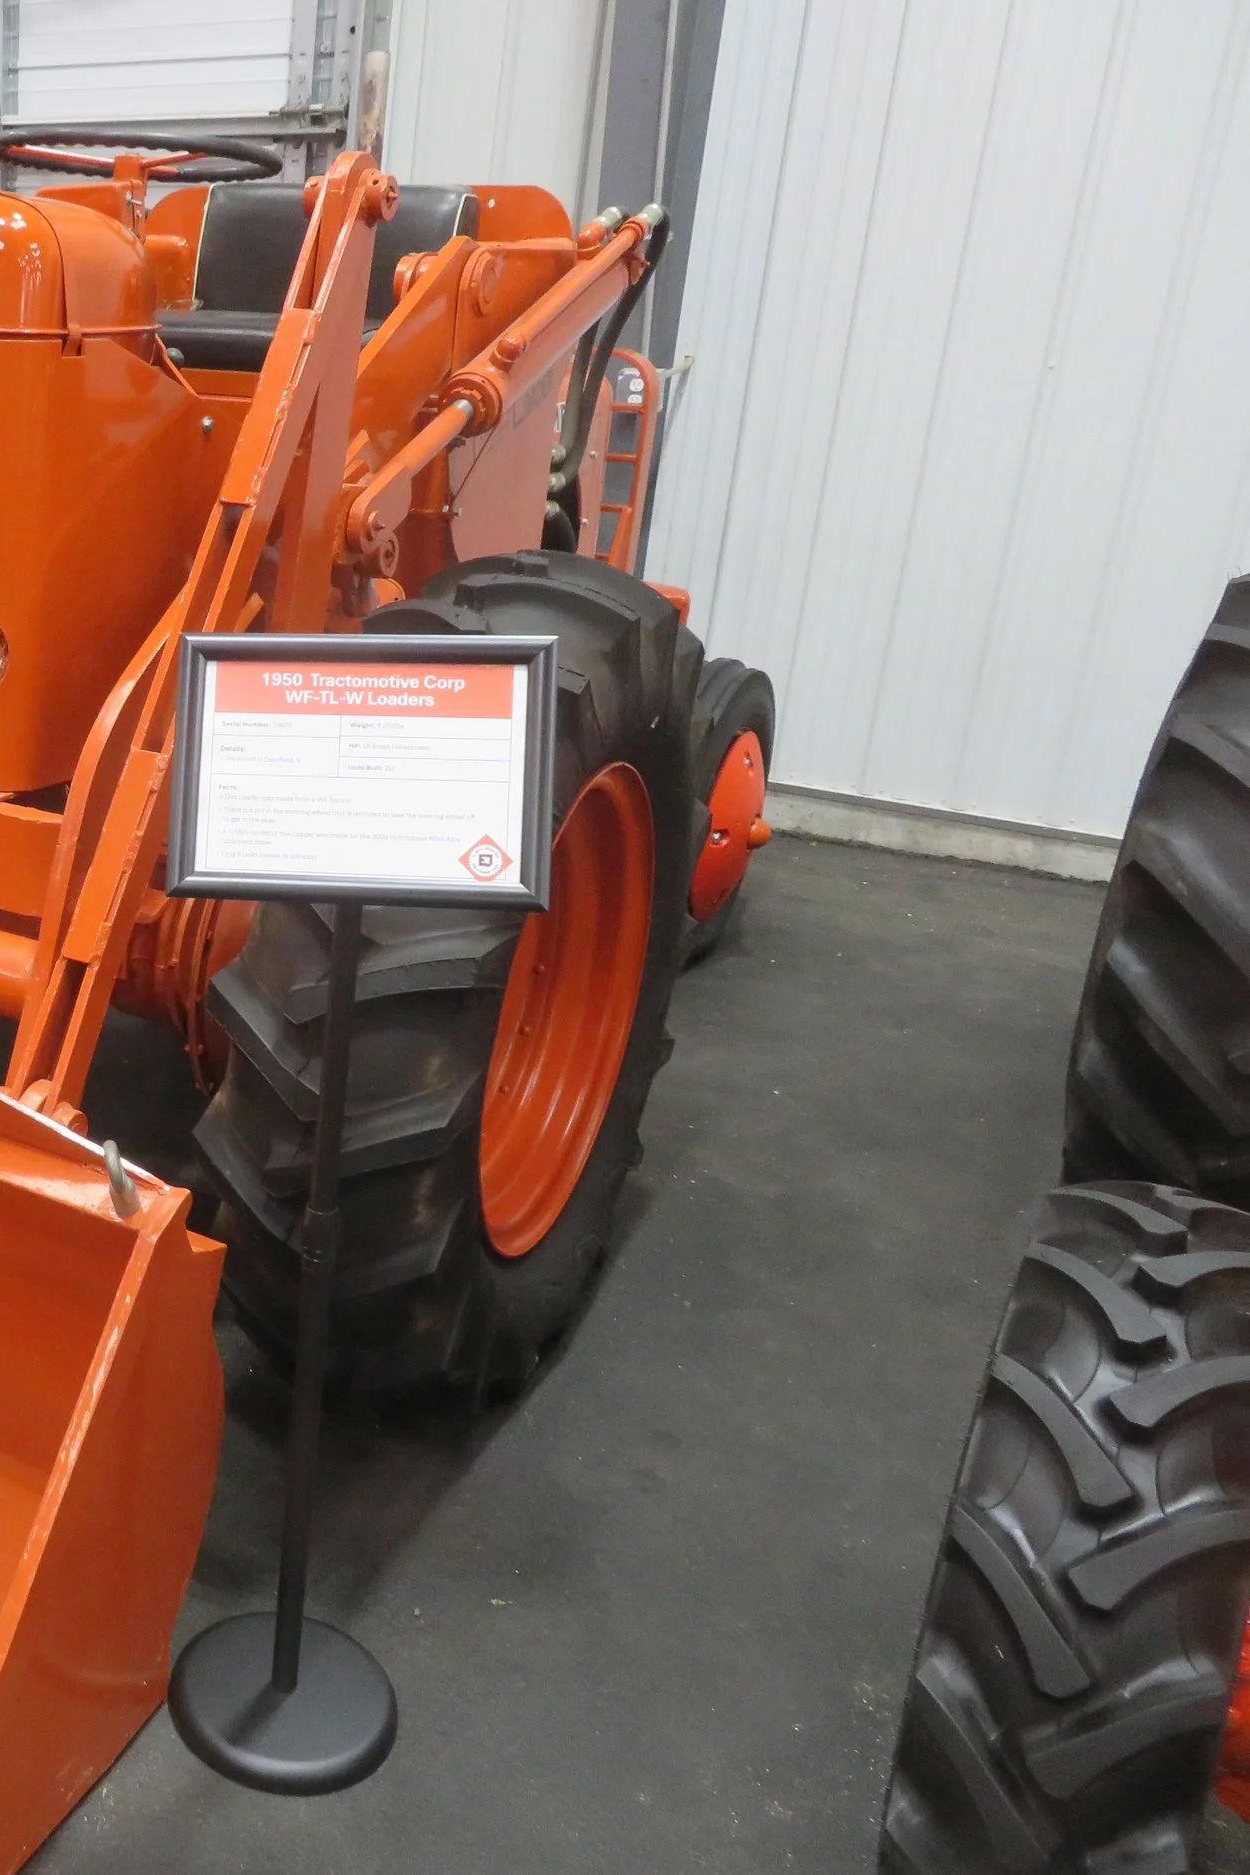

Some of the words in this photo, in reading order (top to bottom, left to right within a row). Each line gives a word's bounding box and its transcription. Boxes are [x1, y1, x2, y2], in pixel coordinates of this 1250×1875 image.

[262, 673, 302, 686] 1950
[310, 673, 419, 688] Tractomotive
[424, 675, 465, 692] Corp
[285, 690, 364, 704] WF-TL-W
[368, 692, 435, 706] Loaders
